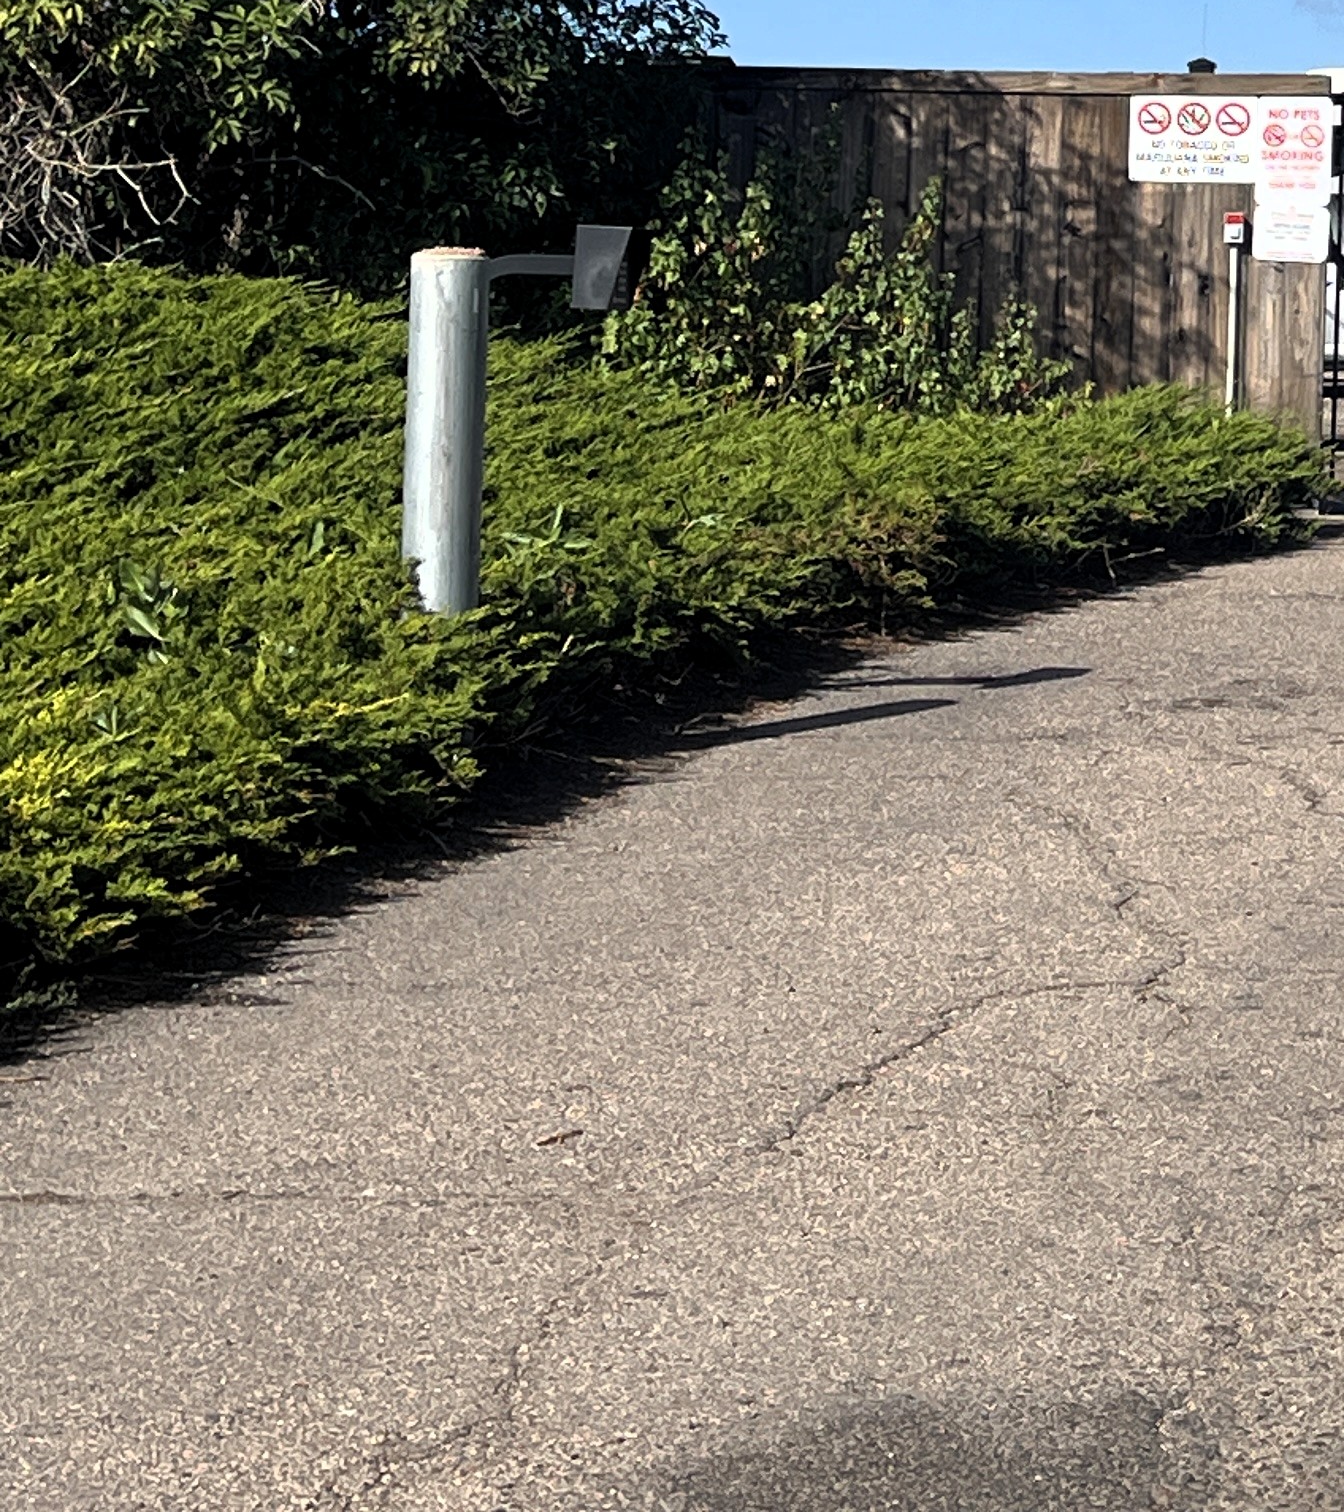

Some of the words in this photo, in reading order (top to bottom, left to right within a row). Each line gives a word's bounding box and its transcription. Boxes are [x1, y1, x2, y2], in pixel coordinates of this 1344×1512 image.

[1268, 108, 1289, 120] NO
[1293, 109, 1320, 120] PETS
[1261, 150, 1325, 162] SMOKING
